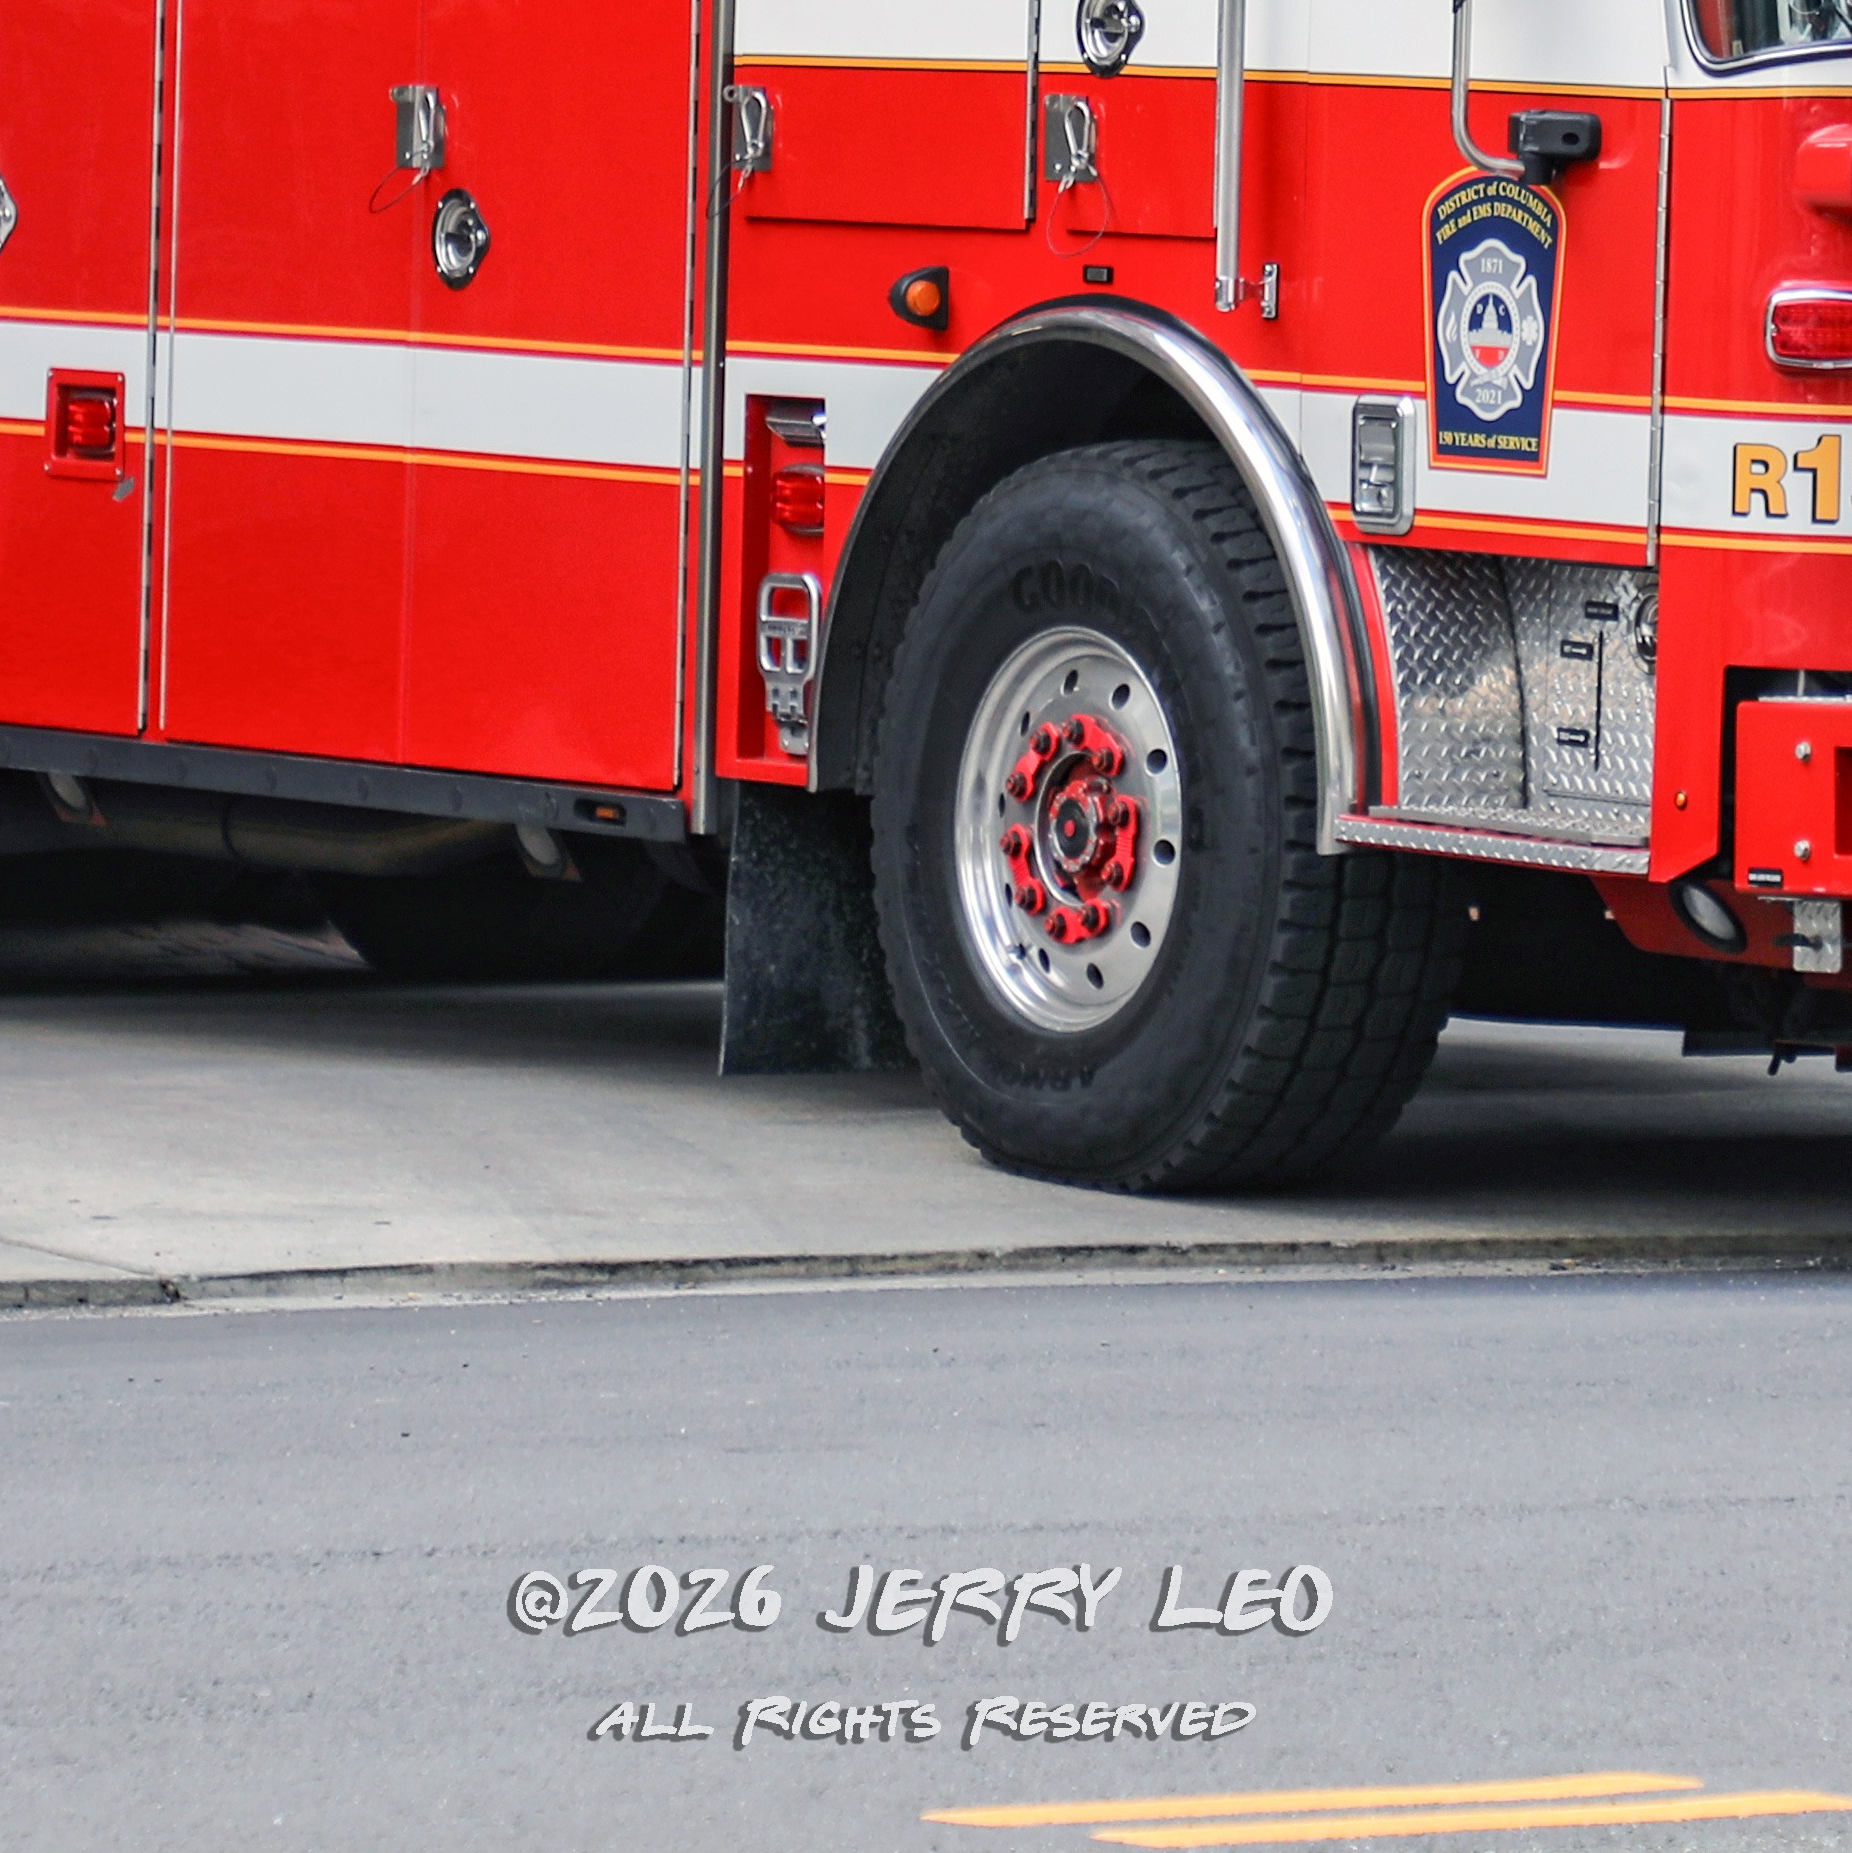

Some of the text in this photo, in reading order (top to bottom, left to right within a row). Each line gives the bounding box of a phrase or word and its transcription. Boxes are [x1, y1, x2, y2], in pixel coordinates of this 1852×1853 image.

[1437, 181, 1552, 227] DISTRICT of COLUMBIA
[1436, 201, 1553, 249] FIRE and EMS DEPARTMENT
[1480, 258, 1503, 274] 1871
[1475, 388, 1503, 404] 2021
[1454, 431, 1486, 448] YEARS
[1487, 434, 1497, 448] of
[1497, 435, 1539, 451] SERVICE
